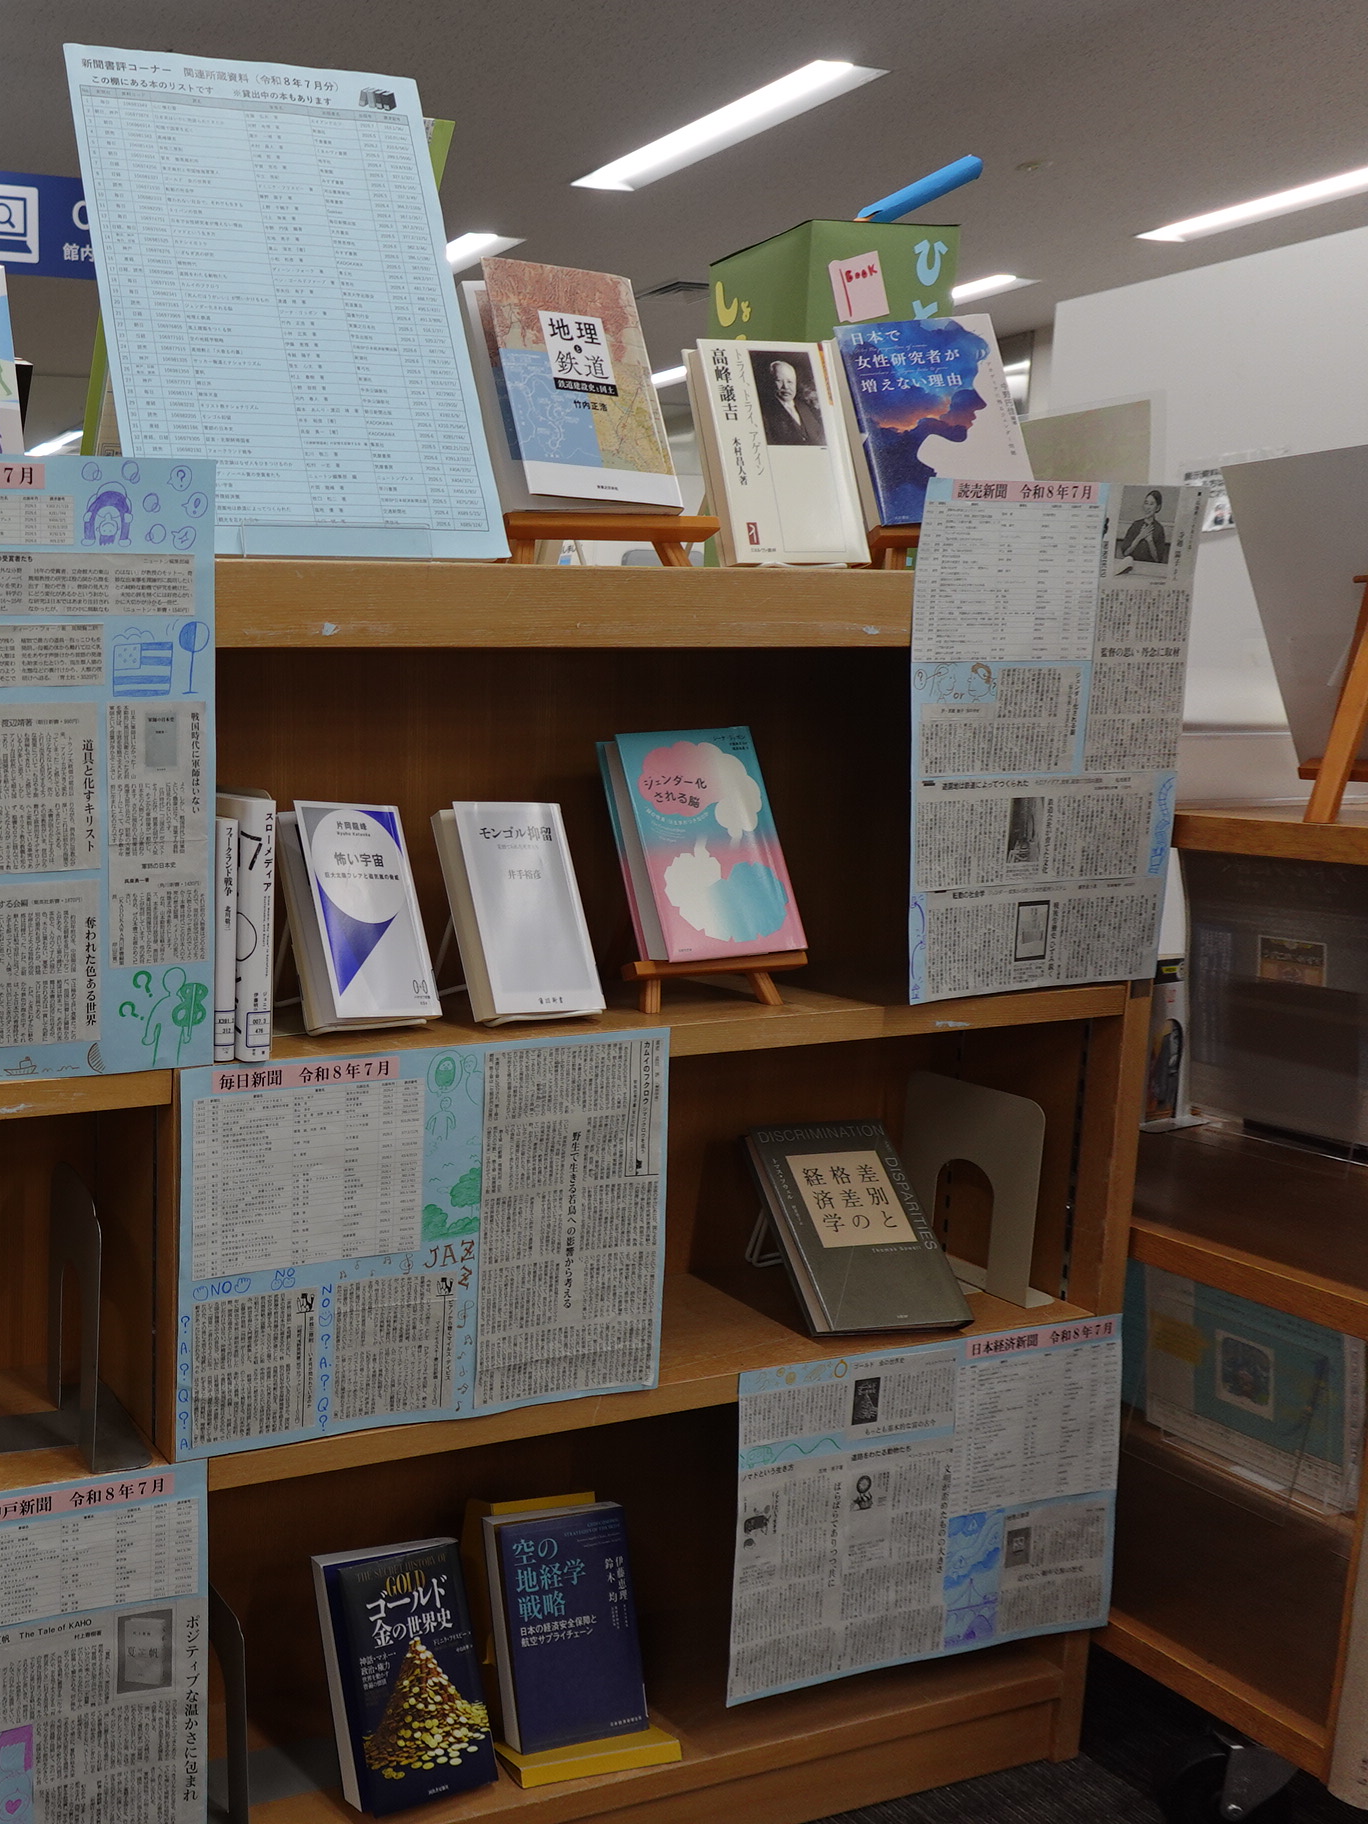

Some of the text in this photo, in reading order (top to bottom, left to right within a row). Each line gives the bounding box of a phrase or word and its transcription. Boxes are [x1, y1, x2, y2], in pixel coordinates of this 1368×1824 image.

[91, 75, 215, 95] この棚にある本のリストです
[548, 317, 602, 346] 地理
[850, 329, 901, 346] 日本で
[555, 350, 610, 379] 鉄道
[854, 349, 960, 370] 女性研究者が
[557, 379, 617, 396] 鉄道建設史と国土
[710, 348, 739, 422] 高峰譲吉
[860, 372, 963, 394] 増えない理由
[573, 400, 608, 412] 竹内正浩
[734, 349, 766, 477] トライ、トライ、アゲイン
[957, 482, 1093, 500] 読売新聞 令和8年7月
[189, 712, 203, 815] 戦国時代に軍師はいない
[81, 739, 97, 853] 道具と化すキリスト
[643, 775, 708, 791] ジェンダー化
[653, 791, 701, 809] される脳
[478, 825, 554, 843] モンゴル抑留
[261, 812, 274, 894] スローメディア
[333, 851, 385, 869] 怖い宇宙
[84, 915, 99, 1027] 奪われた色ある世界
[218, 1060, 391, 1091] 毎日新聞 令和8年7月
[757, 1124, 885, 1144] DISCRIMINATION
[884, 1157, 939, 1251] DISPARITIES
[562, 1131, 582, 1310] 野生で生きる若鳥への影響から考える
[971, 1322, 1114, 1356] 日本経済新聞 令和8年7月
[70, 1477, 167, 1508] 令和8年7月
[511, 1537, 559, 1567] 空の
[385, 1569, 426, 1599] GOLD
[515, 1557, 587, 1594] 地経学
[365, 1575, 449, 1622] ゴールド
[517, 1590, 567, 1623] 戦略
[19, 1630, 36, 1640] The
[38, 1625, 57, 1636] Tale
[57, 1623, 68, 1633] of
[68, 1618, 93, 1630] KAHO
[371, 1607, 454, 1650] 金の世界史
[519, 1614, 599, 1637] 日本の経済安全保障と
[520, 1626, 595, 1649] 航空サプライチェーン
[182, 1614, 201, 1803] ポジティブな温かさに包まれ
